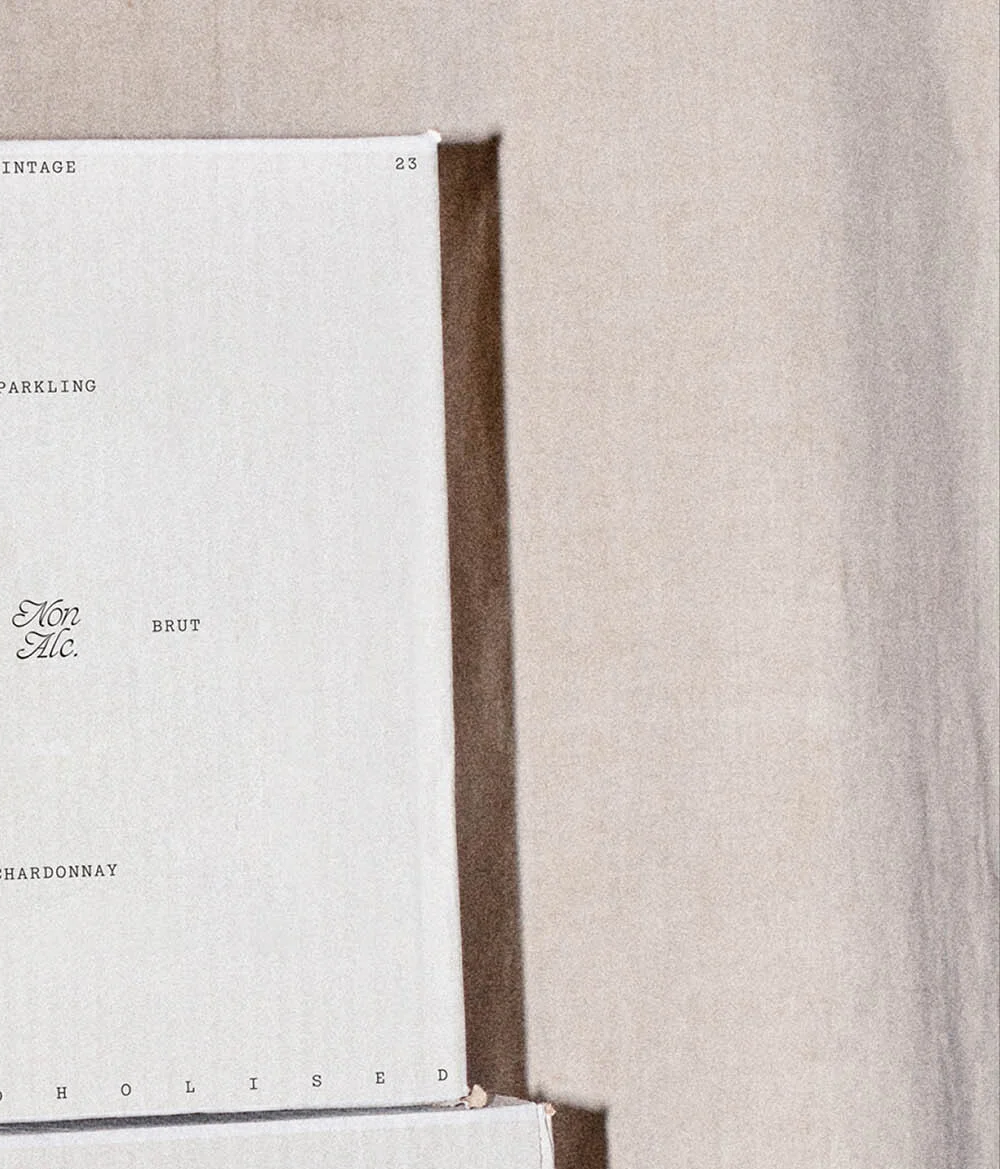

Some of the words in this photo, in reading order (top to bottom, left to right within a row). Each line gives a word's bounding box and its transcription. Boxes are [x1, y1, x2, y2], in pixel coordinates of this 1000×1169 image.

[395, 156, 418, 171] 23
[11, 598, 80, 630] Non
[152, 618, 201, 633] BRUT
[15, 627, 78, 660] Alc.
